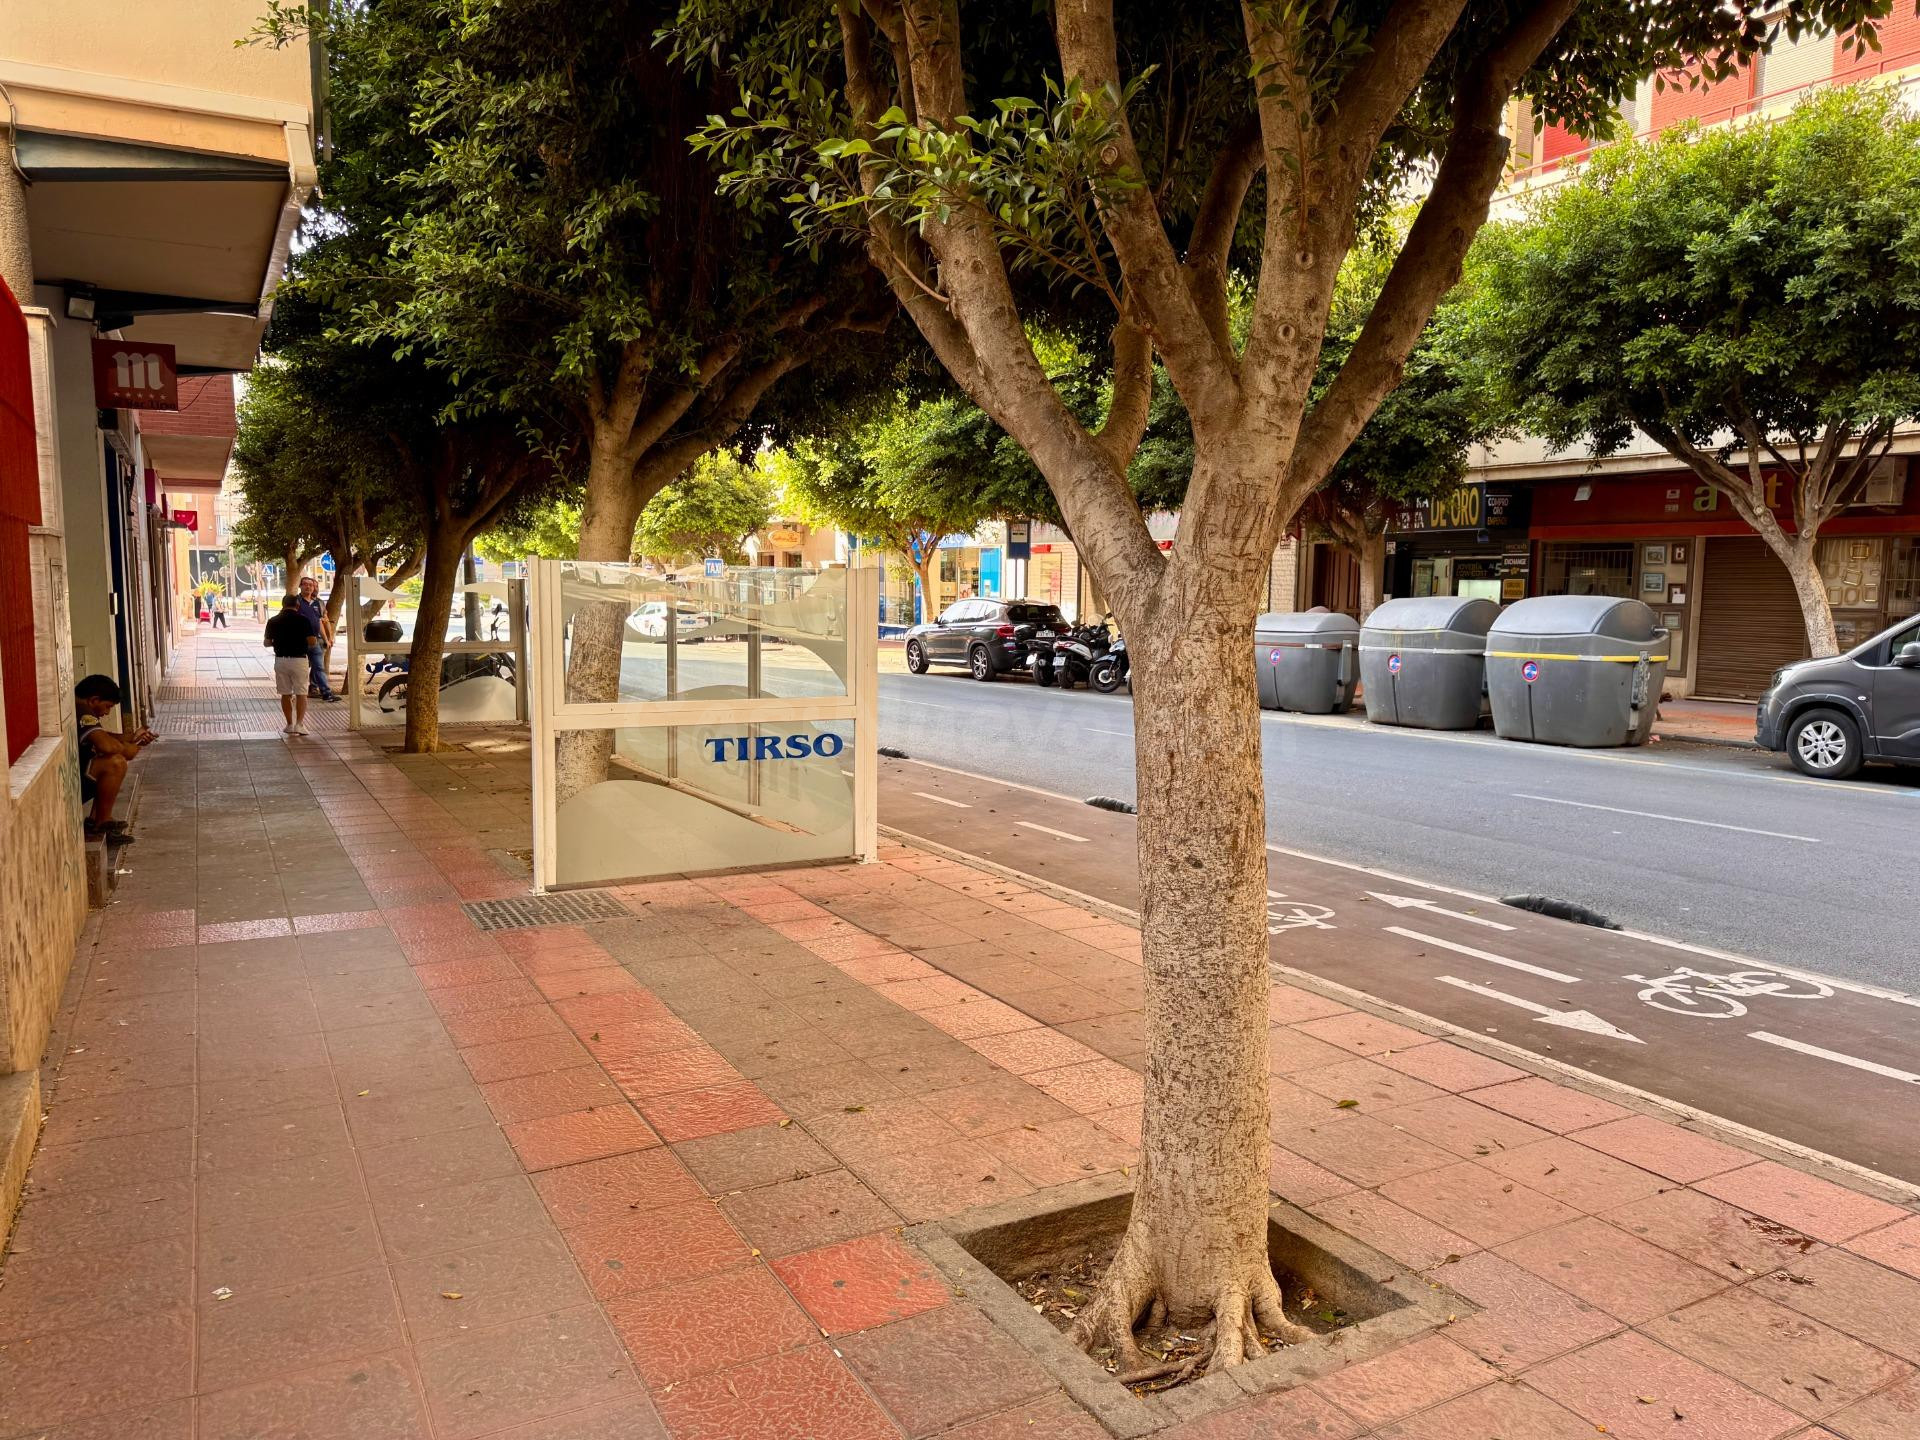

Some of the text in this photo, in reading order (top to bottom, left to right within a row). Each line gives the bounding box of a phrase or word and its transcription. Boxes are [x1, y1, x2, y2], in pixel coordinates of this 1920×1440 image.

[1450, 486, 1480, 527] ORO
[706, 562, 722, 574] TAXI
[704, 733, 844, 762] TIRSO
